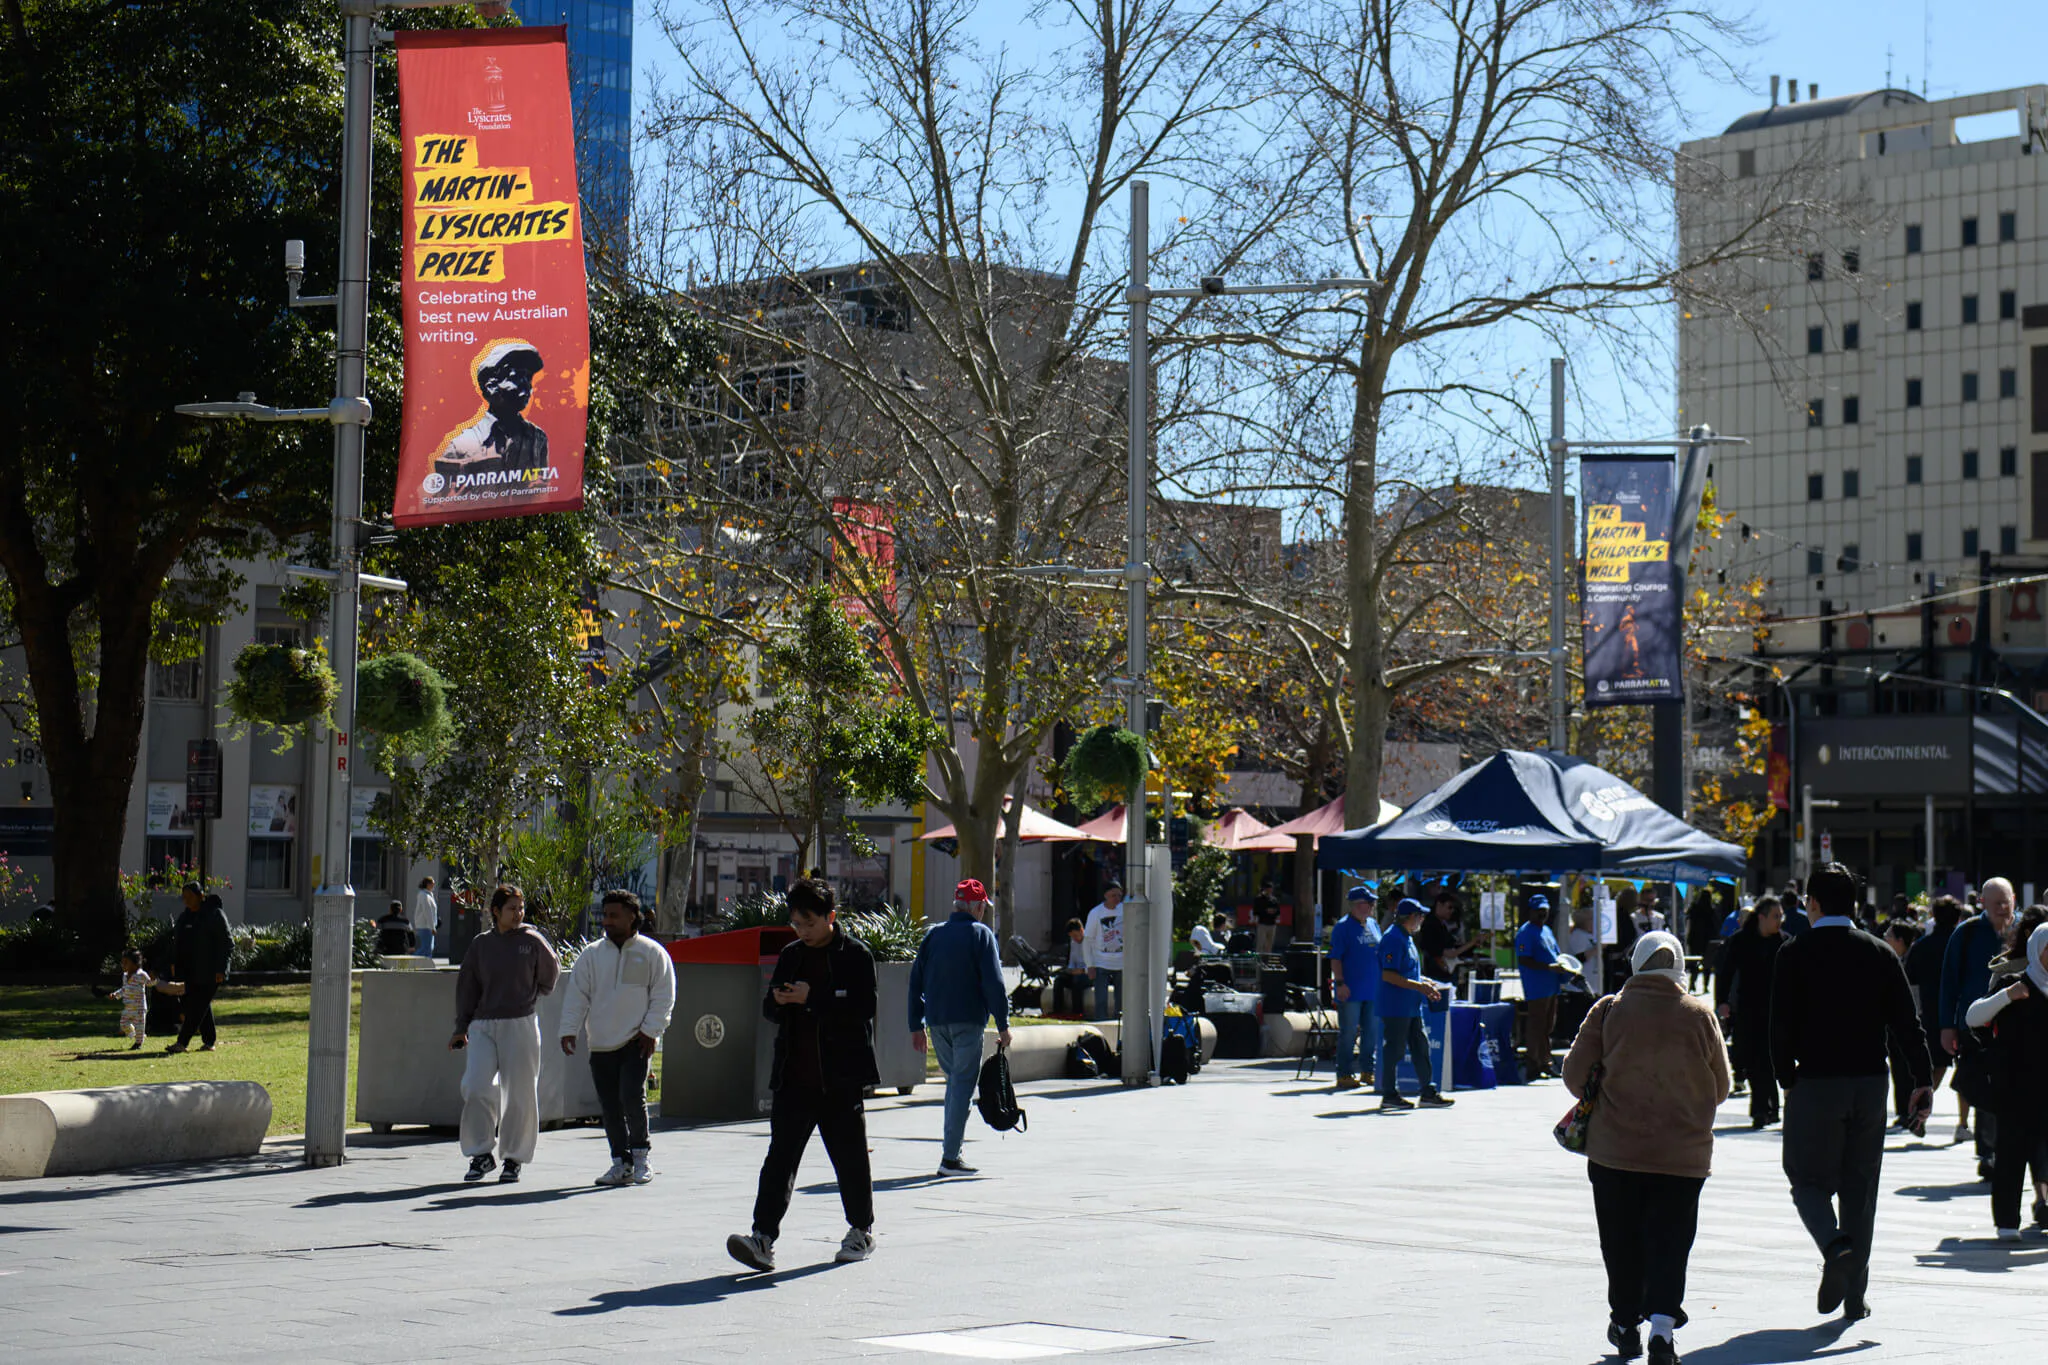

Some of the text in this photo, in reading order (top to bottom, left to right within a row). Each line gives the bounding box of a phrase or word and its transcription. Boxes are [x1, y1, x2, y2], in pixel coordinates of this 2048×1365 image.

[467, 111, 512, 126] Lysicrates
[472, 107, 483, 115] The
[478, 123, 511, 131] Foundation
[421, 138, 467, 164] THE
[418, 174, 527, 203] MARTIN-
[419, 208, 570, 240] LYSICRATES
[418, 250, 497, 278] PRIZE
[418, 287, 537, 305] Celebrating the
[419, 304, 568, 324] best new Australian
[419, 328, 478, 344] writing.
[456, 466, 559, 488] PARRAMATTA
[422, 486, 559, 504] Supported by City of Parramatta
[1592, 507, 1616, 520] THE
[1591, 526, 1642, 540] MARTIN
[1589, 544, 1665, 560] CHILDREN'S
[1589, 565, 1625, 579] WALK
[1586, 582, 1669, 594] Celebrating Courage
[1614, 678, 1671, 689] PARRAMATTA
[1839, 744, 1950, 761] INTERCONTINENTAL
